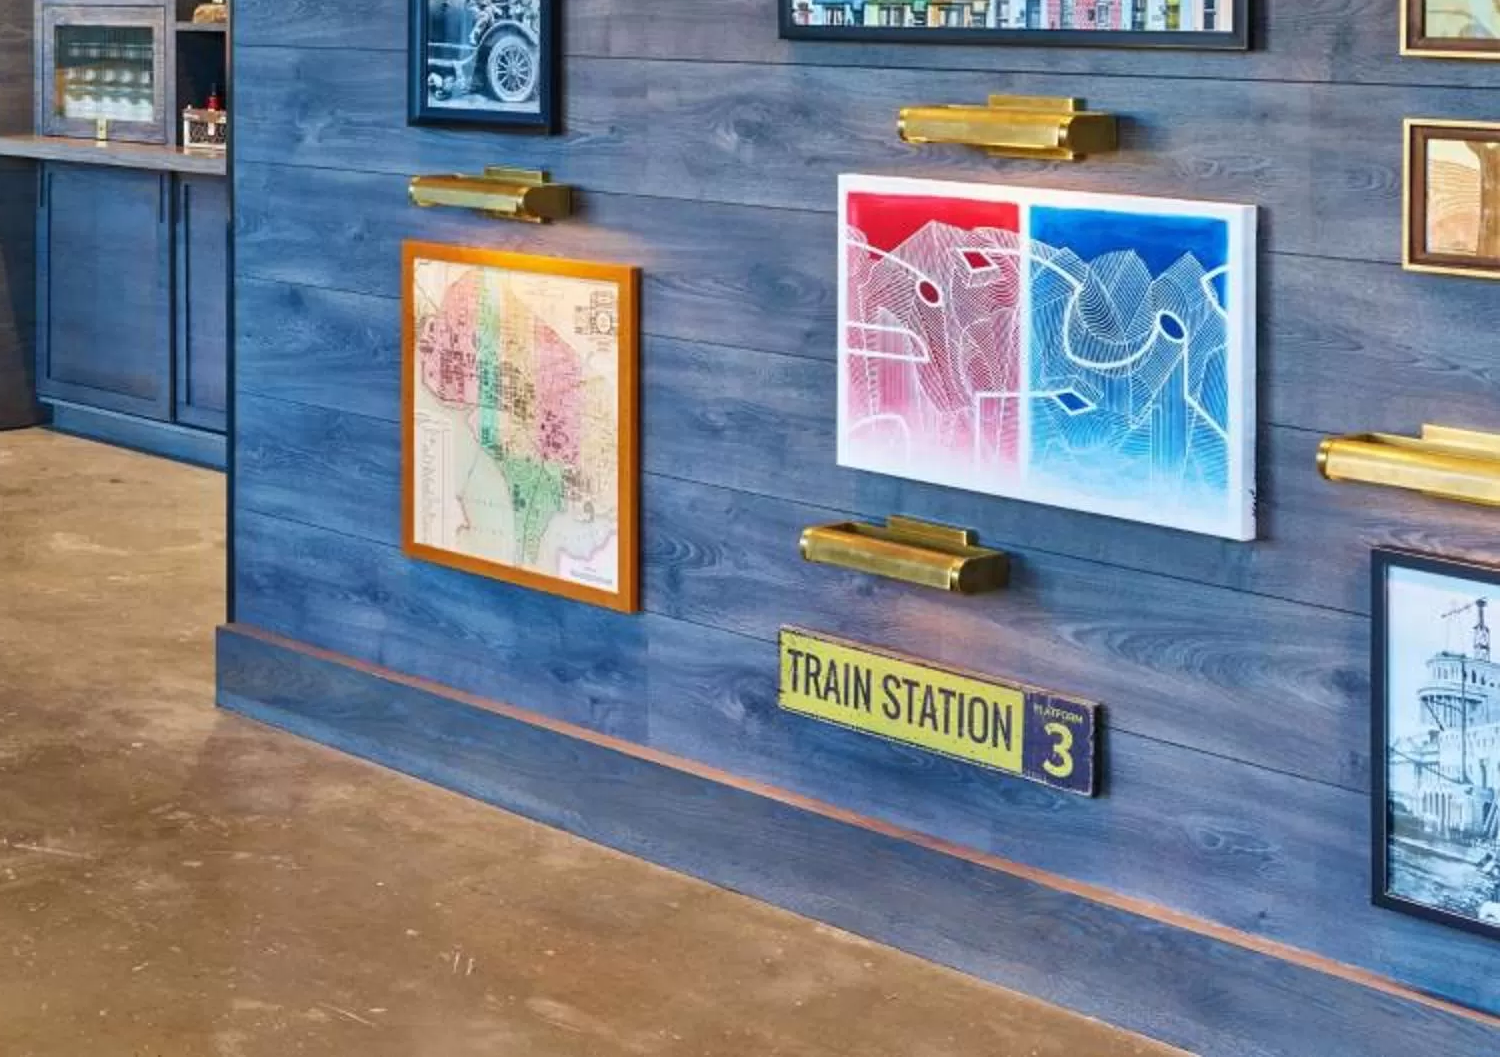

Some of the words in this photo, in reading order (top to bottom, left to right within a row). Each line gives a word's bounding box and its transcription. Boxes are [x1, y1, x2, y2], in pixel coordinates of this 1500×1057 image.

[787, 648, 872, 713] TRAIN
[881, 674, 1012, 752] STATION
[1033, 703, 1083, 723] PLATFORM
[1043, 722, 1073, 778] 3
